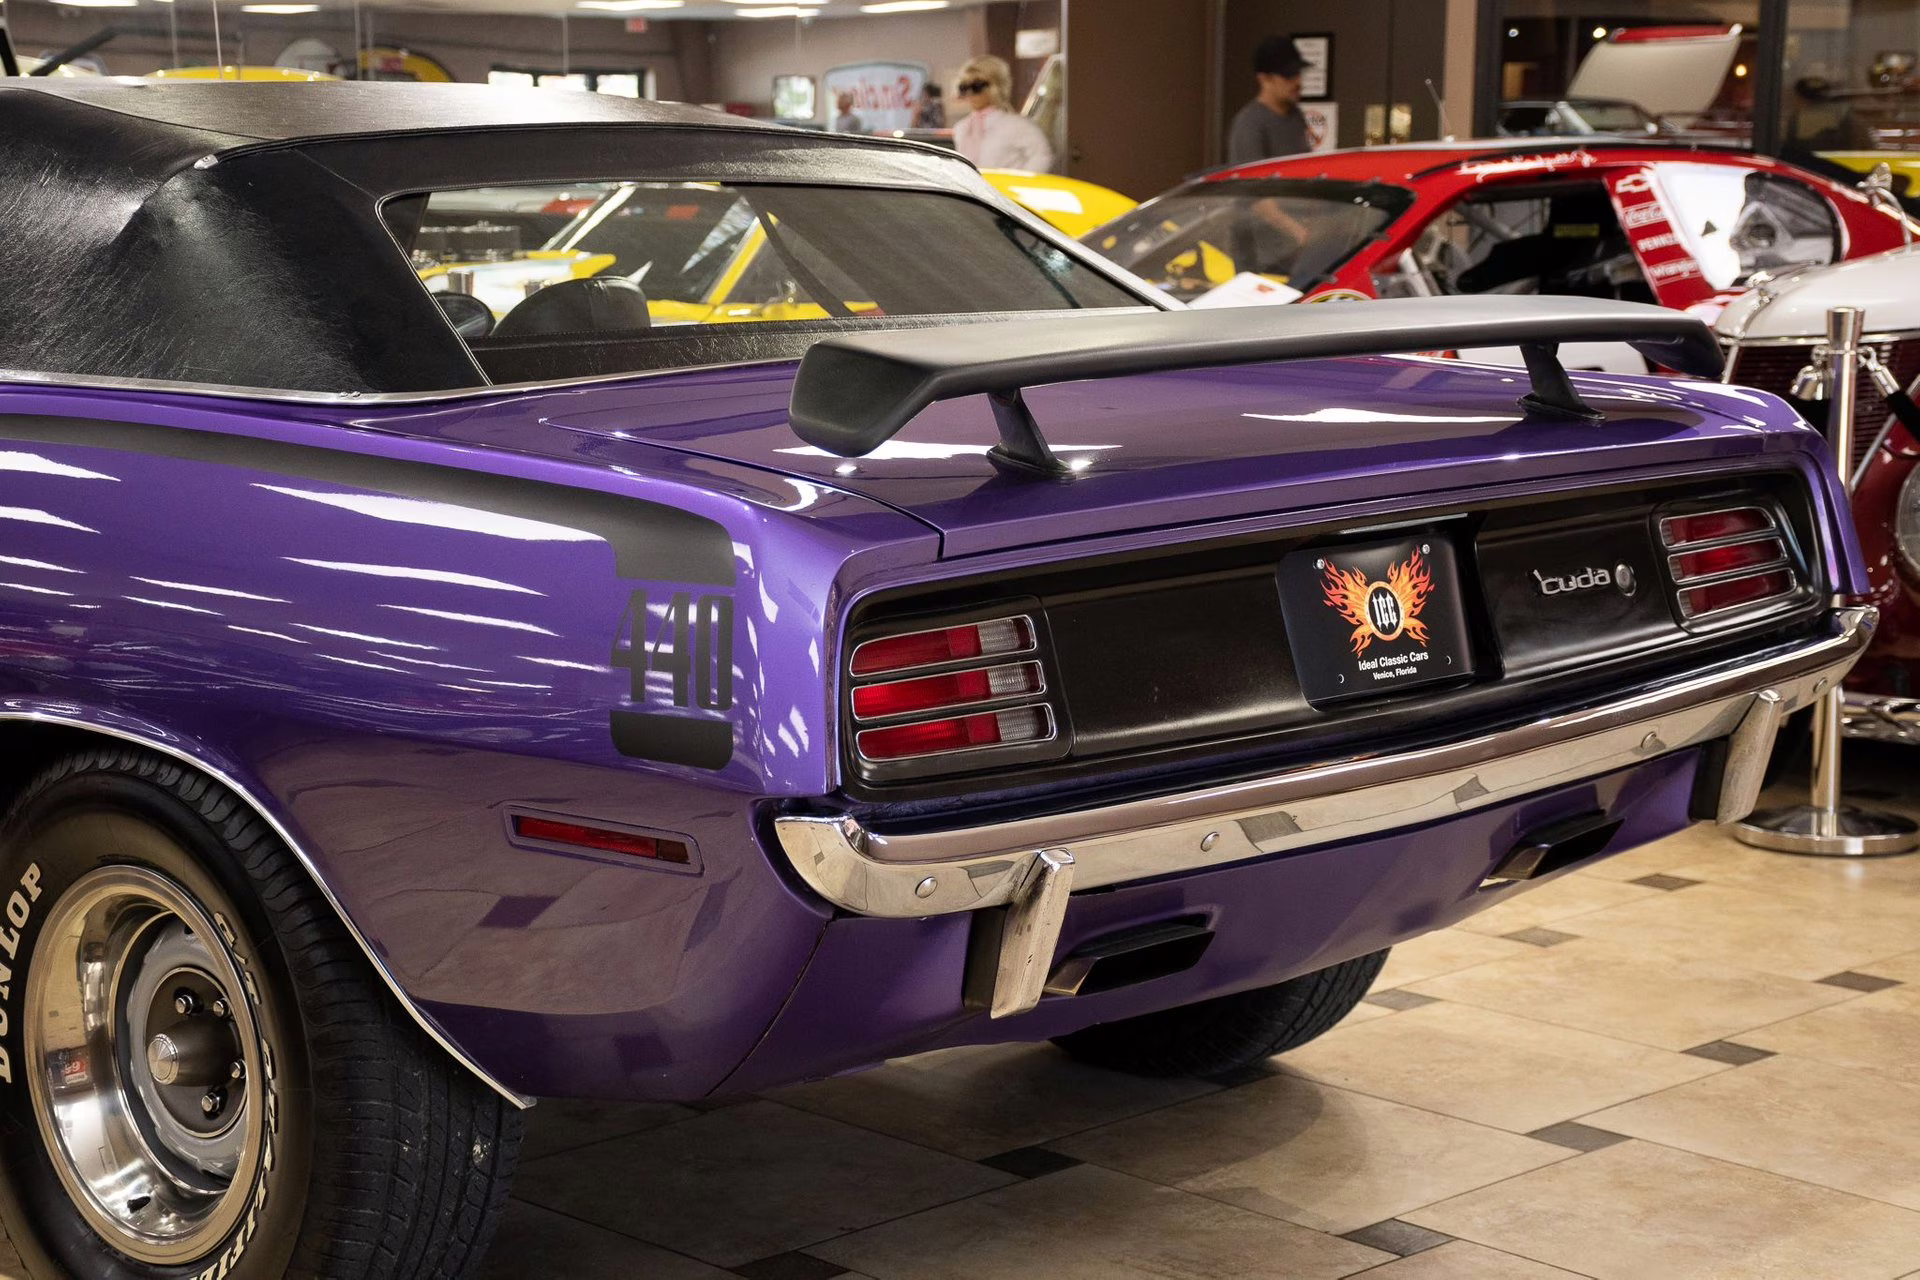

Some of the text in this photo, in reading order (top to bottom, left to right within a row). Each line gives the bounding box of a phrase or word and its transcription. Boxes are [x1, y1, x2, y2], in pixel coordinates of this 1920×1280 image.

[611, 588, 734, 711] 440
[1358, 651, 1429, 671] Ideal Classic Cars
[1373, 666, 1417, 680] Venice, Florida
